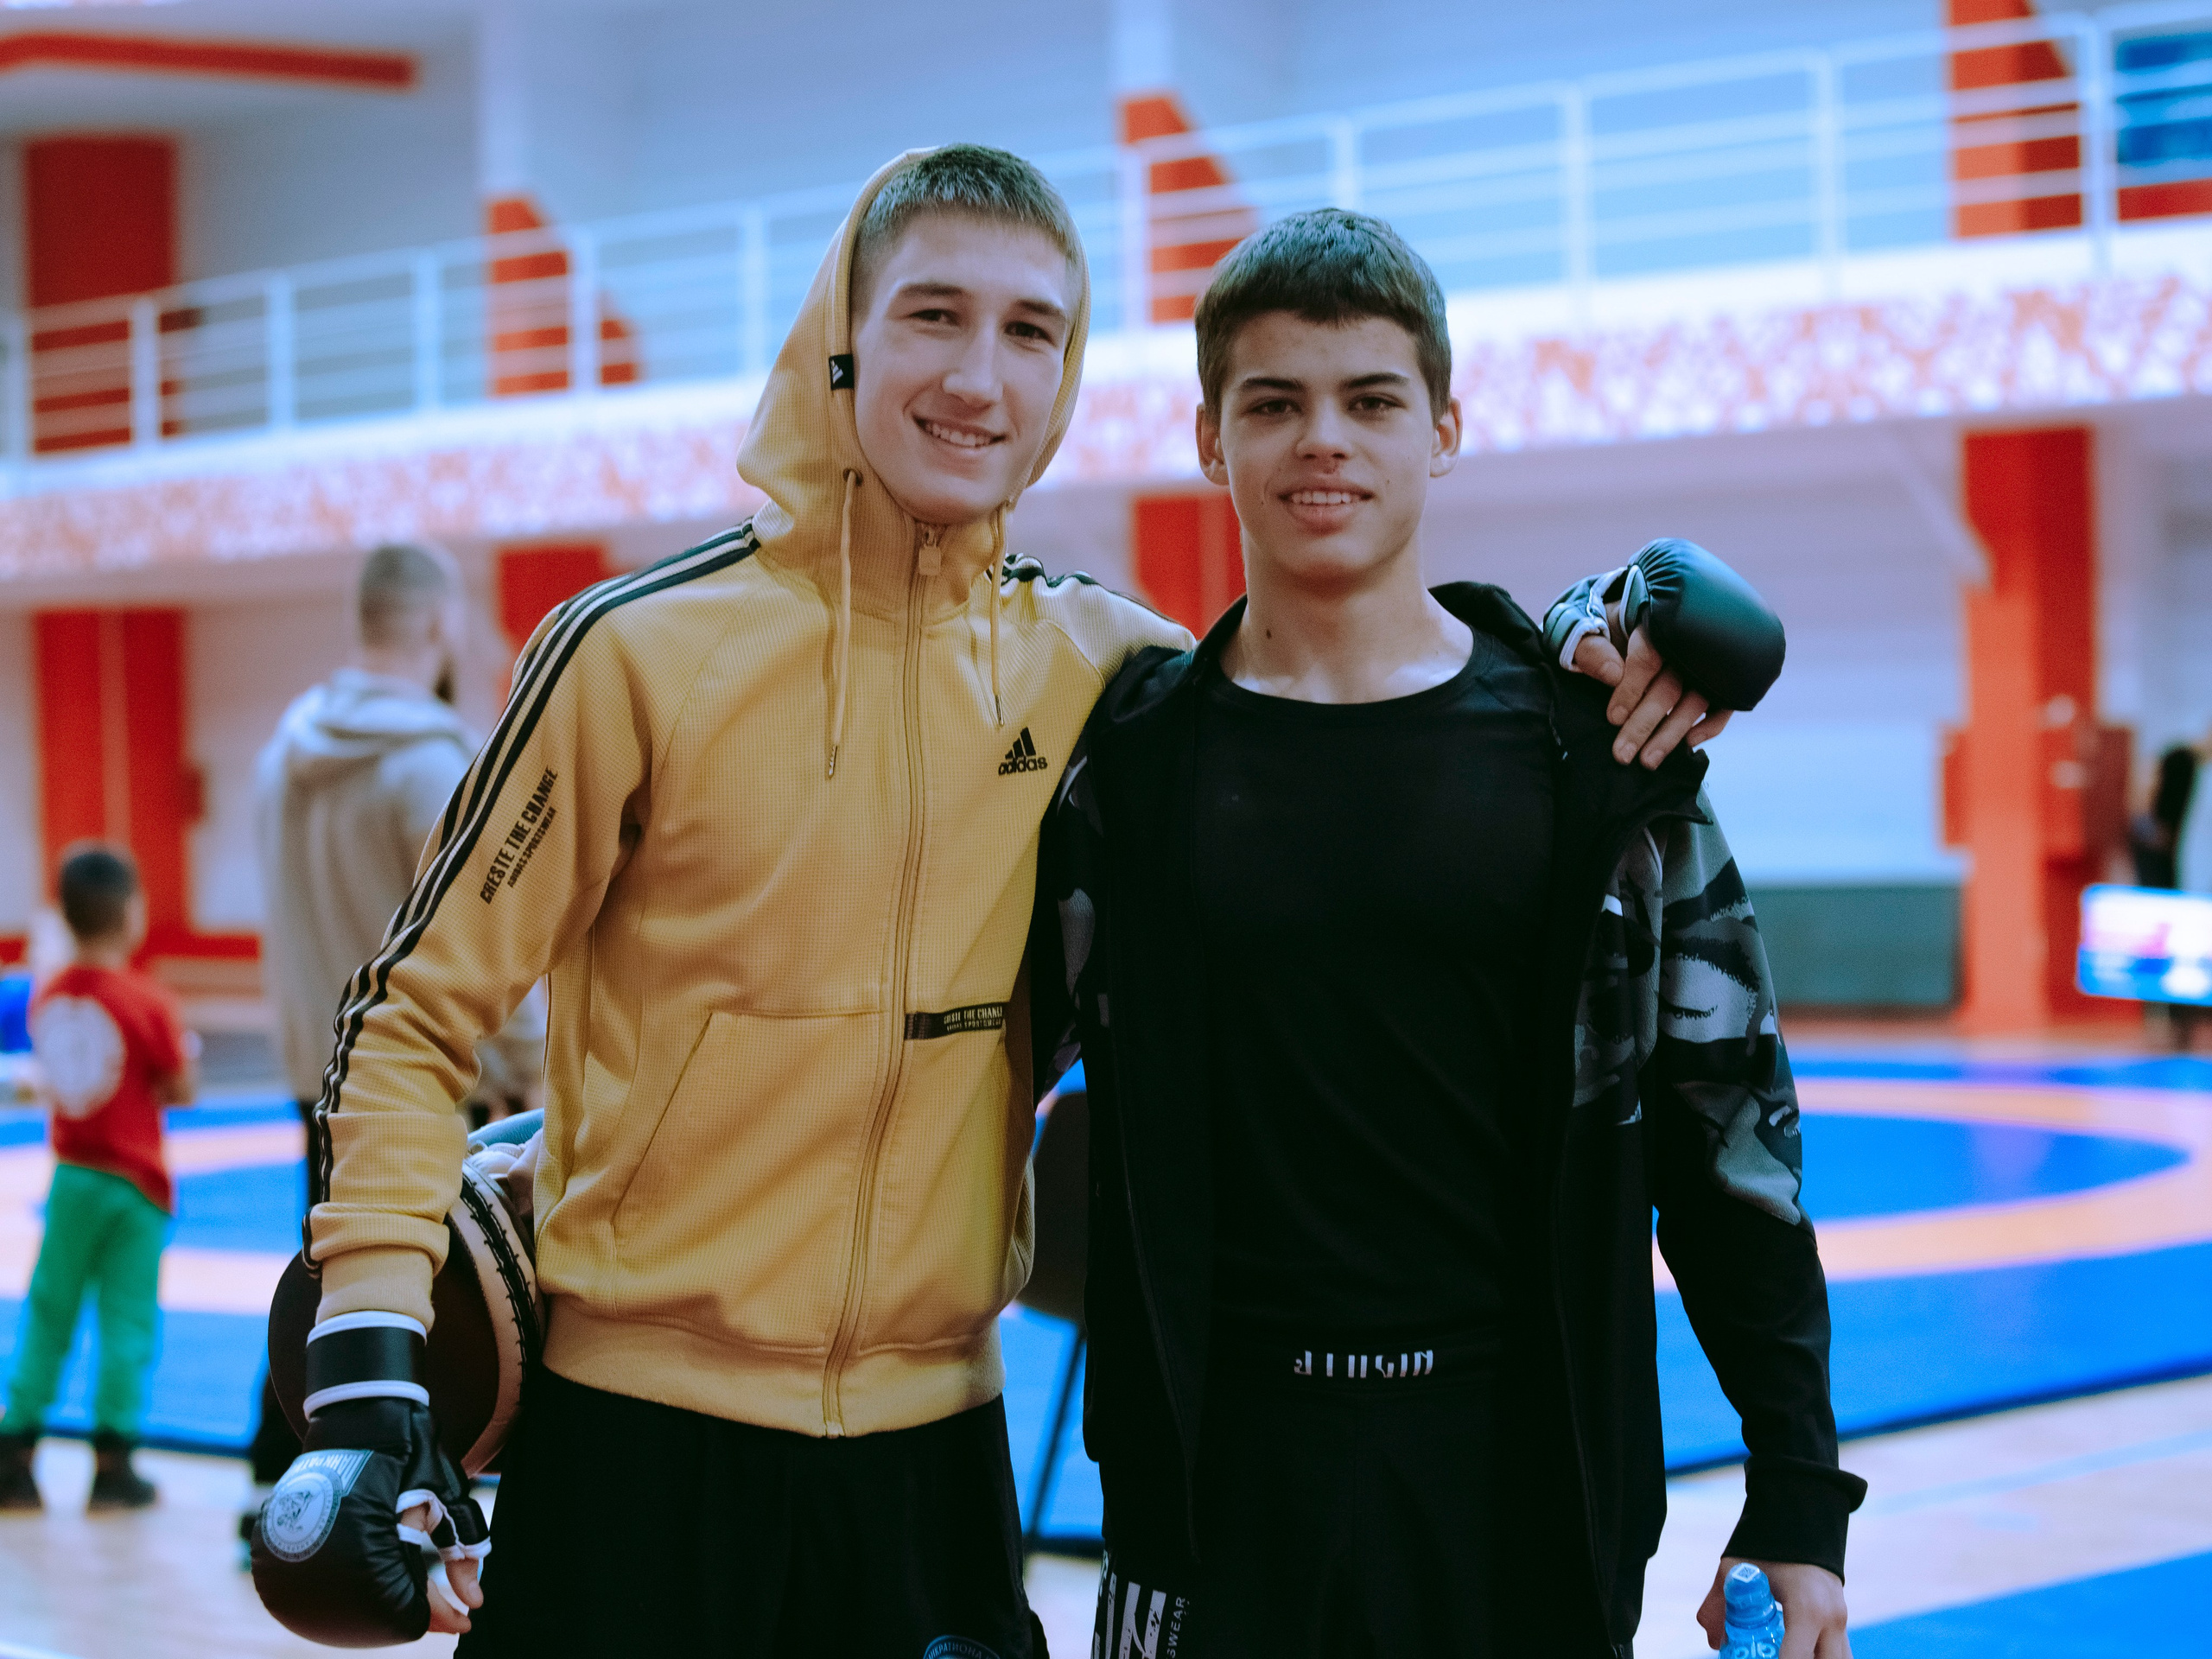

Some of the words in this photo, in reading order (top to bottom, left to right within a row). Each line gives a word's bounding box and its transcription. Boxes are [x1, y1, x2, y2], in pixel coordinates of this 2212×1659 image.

[998, 755, 1048, 776] adidas
[505, 821, 531, 849] THE
[521, 765, 558, 824] CHANGE
